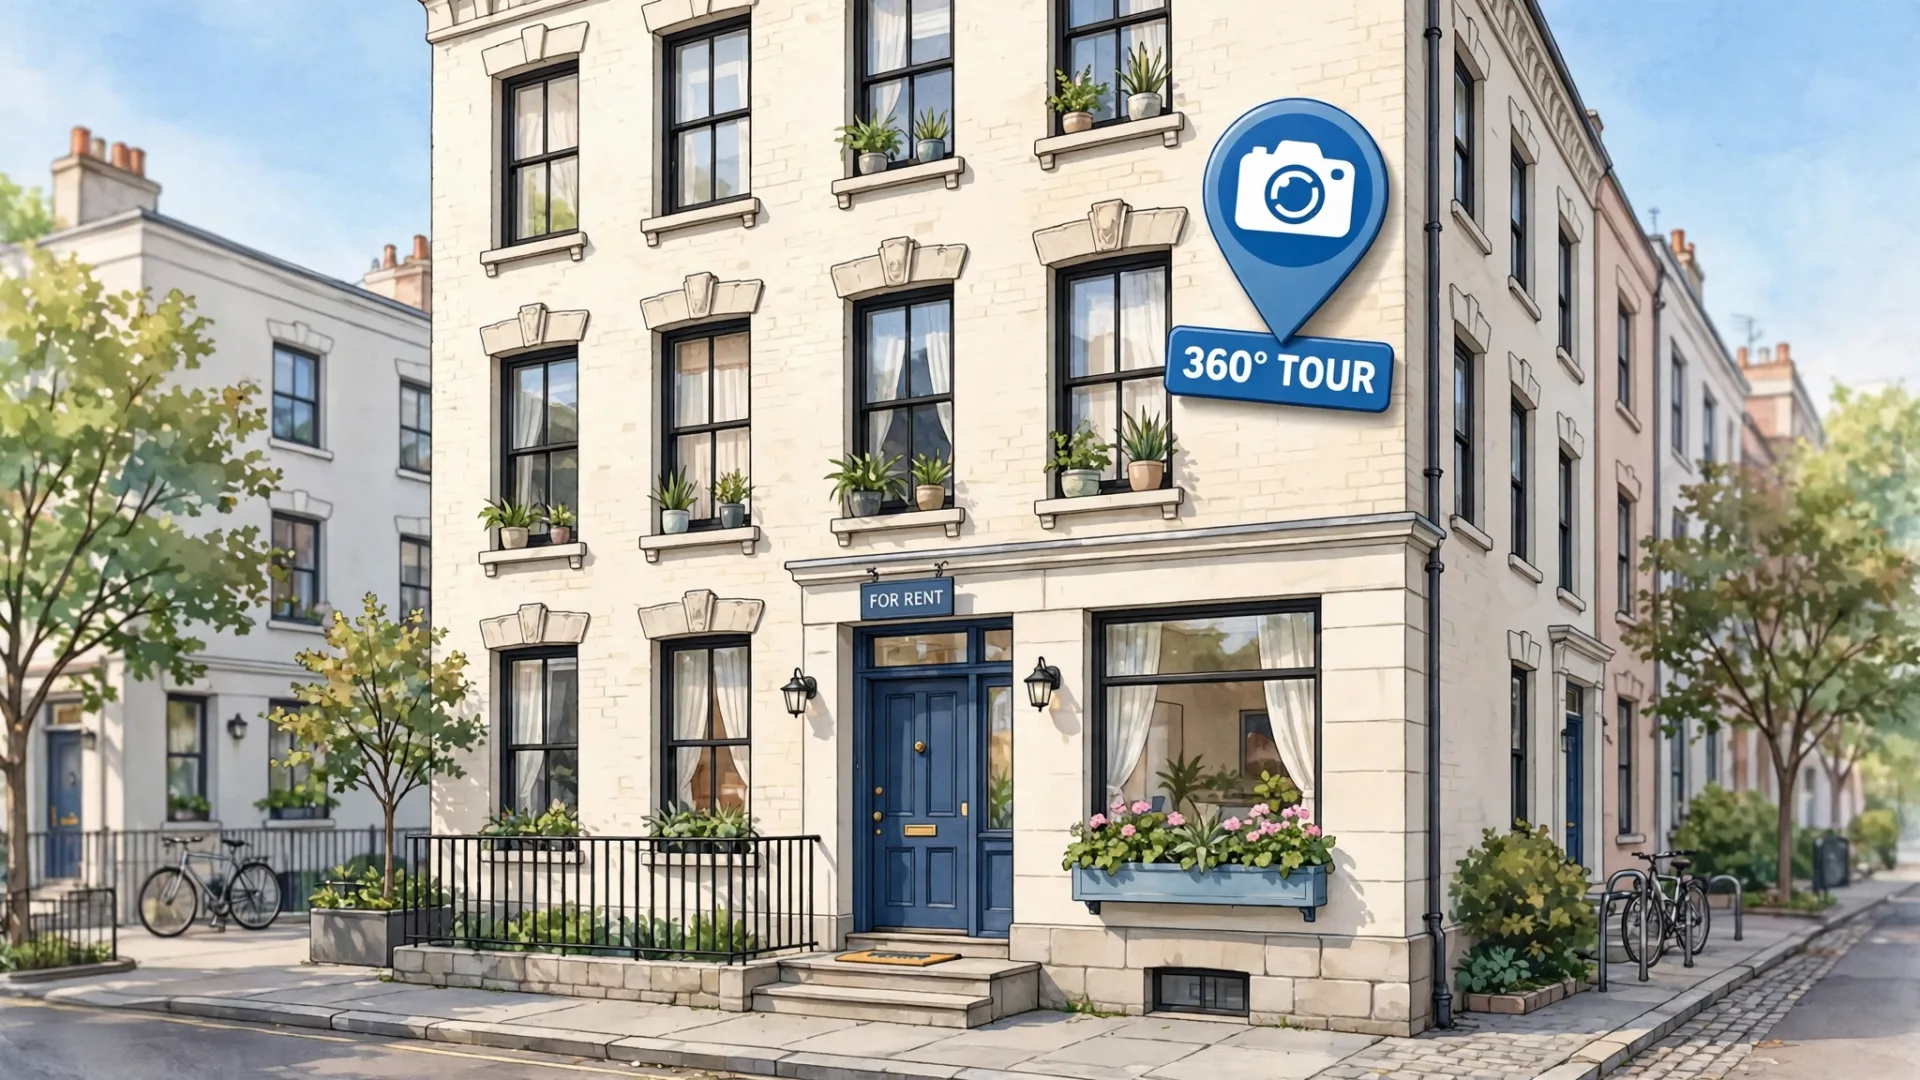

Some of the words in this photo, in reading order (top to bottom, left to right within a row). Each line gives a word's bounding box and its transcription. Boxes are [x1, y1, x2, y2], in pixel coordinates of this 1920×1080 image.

[1182, 345, 1268, 383] 360°
[1277, 353, 1376, 394] TOUR
[870, 593, 899, 608] FOR
[904, 590, 944, 607] RENT
